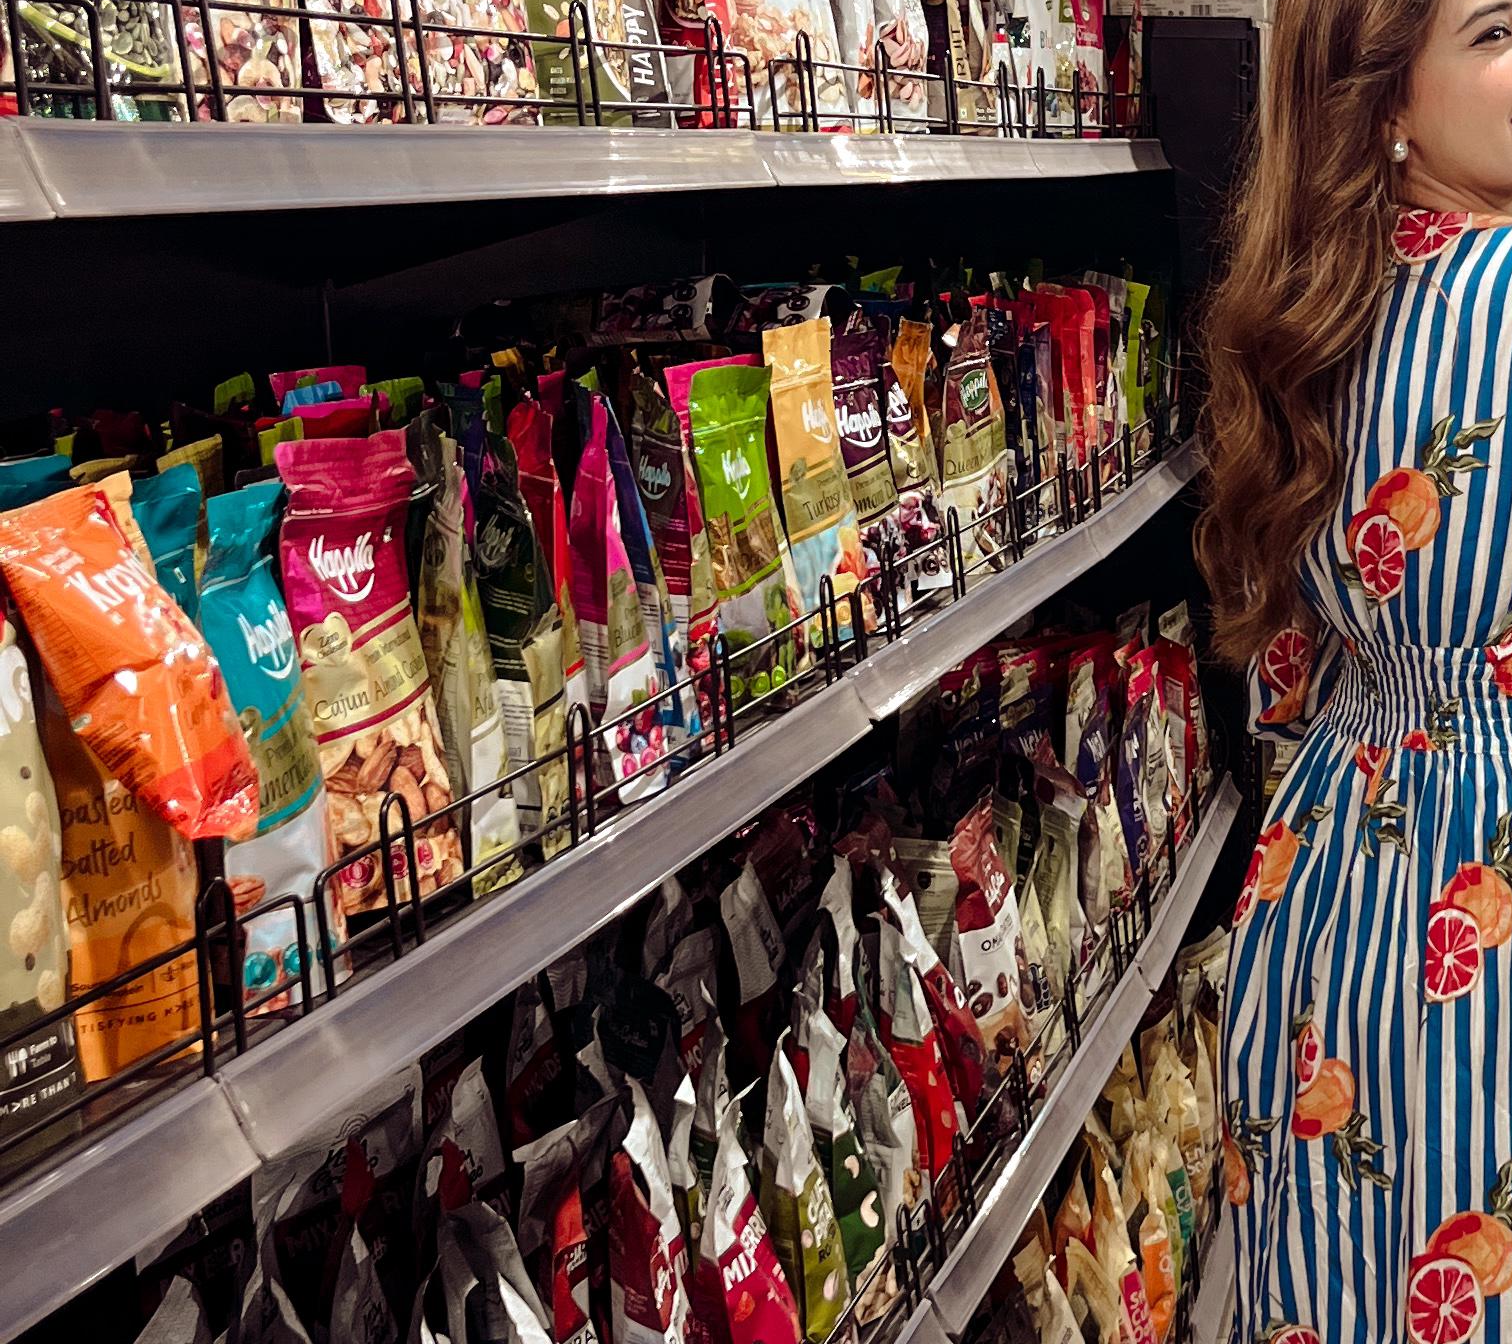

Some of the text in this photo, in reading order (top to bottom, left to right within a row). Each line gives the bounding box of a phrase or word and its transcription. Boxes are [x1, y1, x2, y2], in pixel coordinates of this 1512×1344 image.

[308, 532, 375, 593] Happilo
[314, 687, 371, 722] Cajun
[62, 792, 146, 827] oasted
[67, 872, 163, 927] Almonds
[80, 1011, 157, 1036] TISFYING
